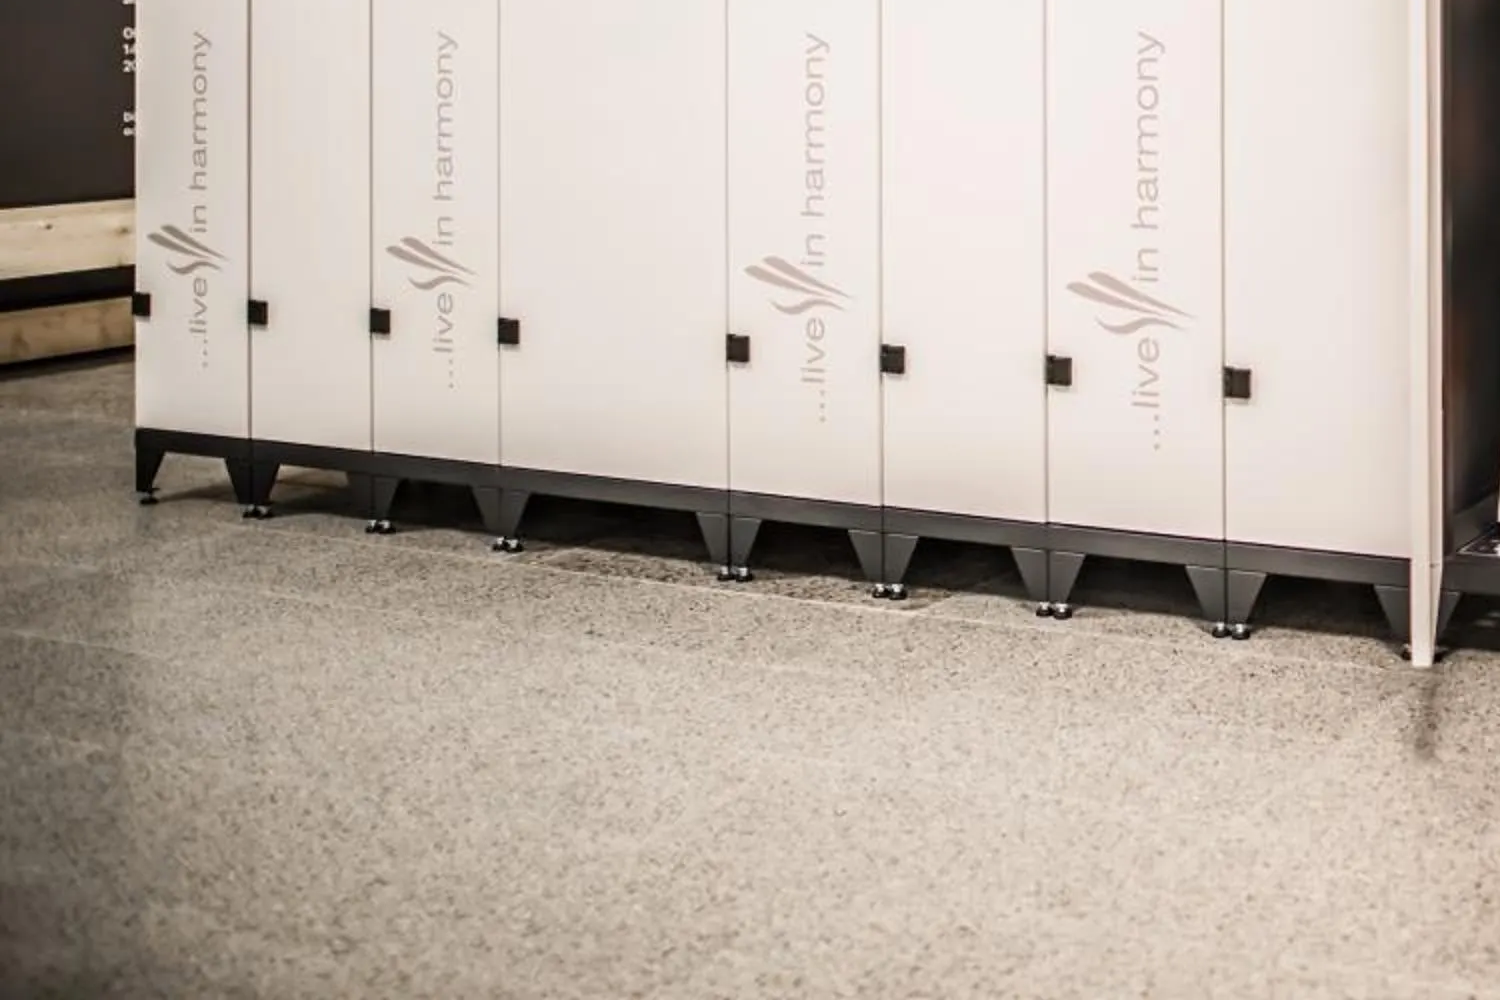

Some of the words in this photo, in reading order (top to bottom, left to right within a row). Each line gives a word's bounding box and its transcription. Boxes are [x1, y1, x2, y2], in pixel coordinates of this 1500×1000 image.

[187, 31, 213, 191] harmony
[431, 30, 460, 202] harmony
[799, 32, 831, 218] harmony
[1129, 31, 1166, 231] harmony
[188, 204, 208, 233] in
[431, 216, 454, 246] in
[799, 233, 825, 268] in
[1131, 247, 1160, 283] in
